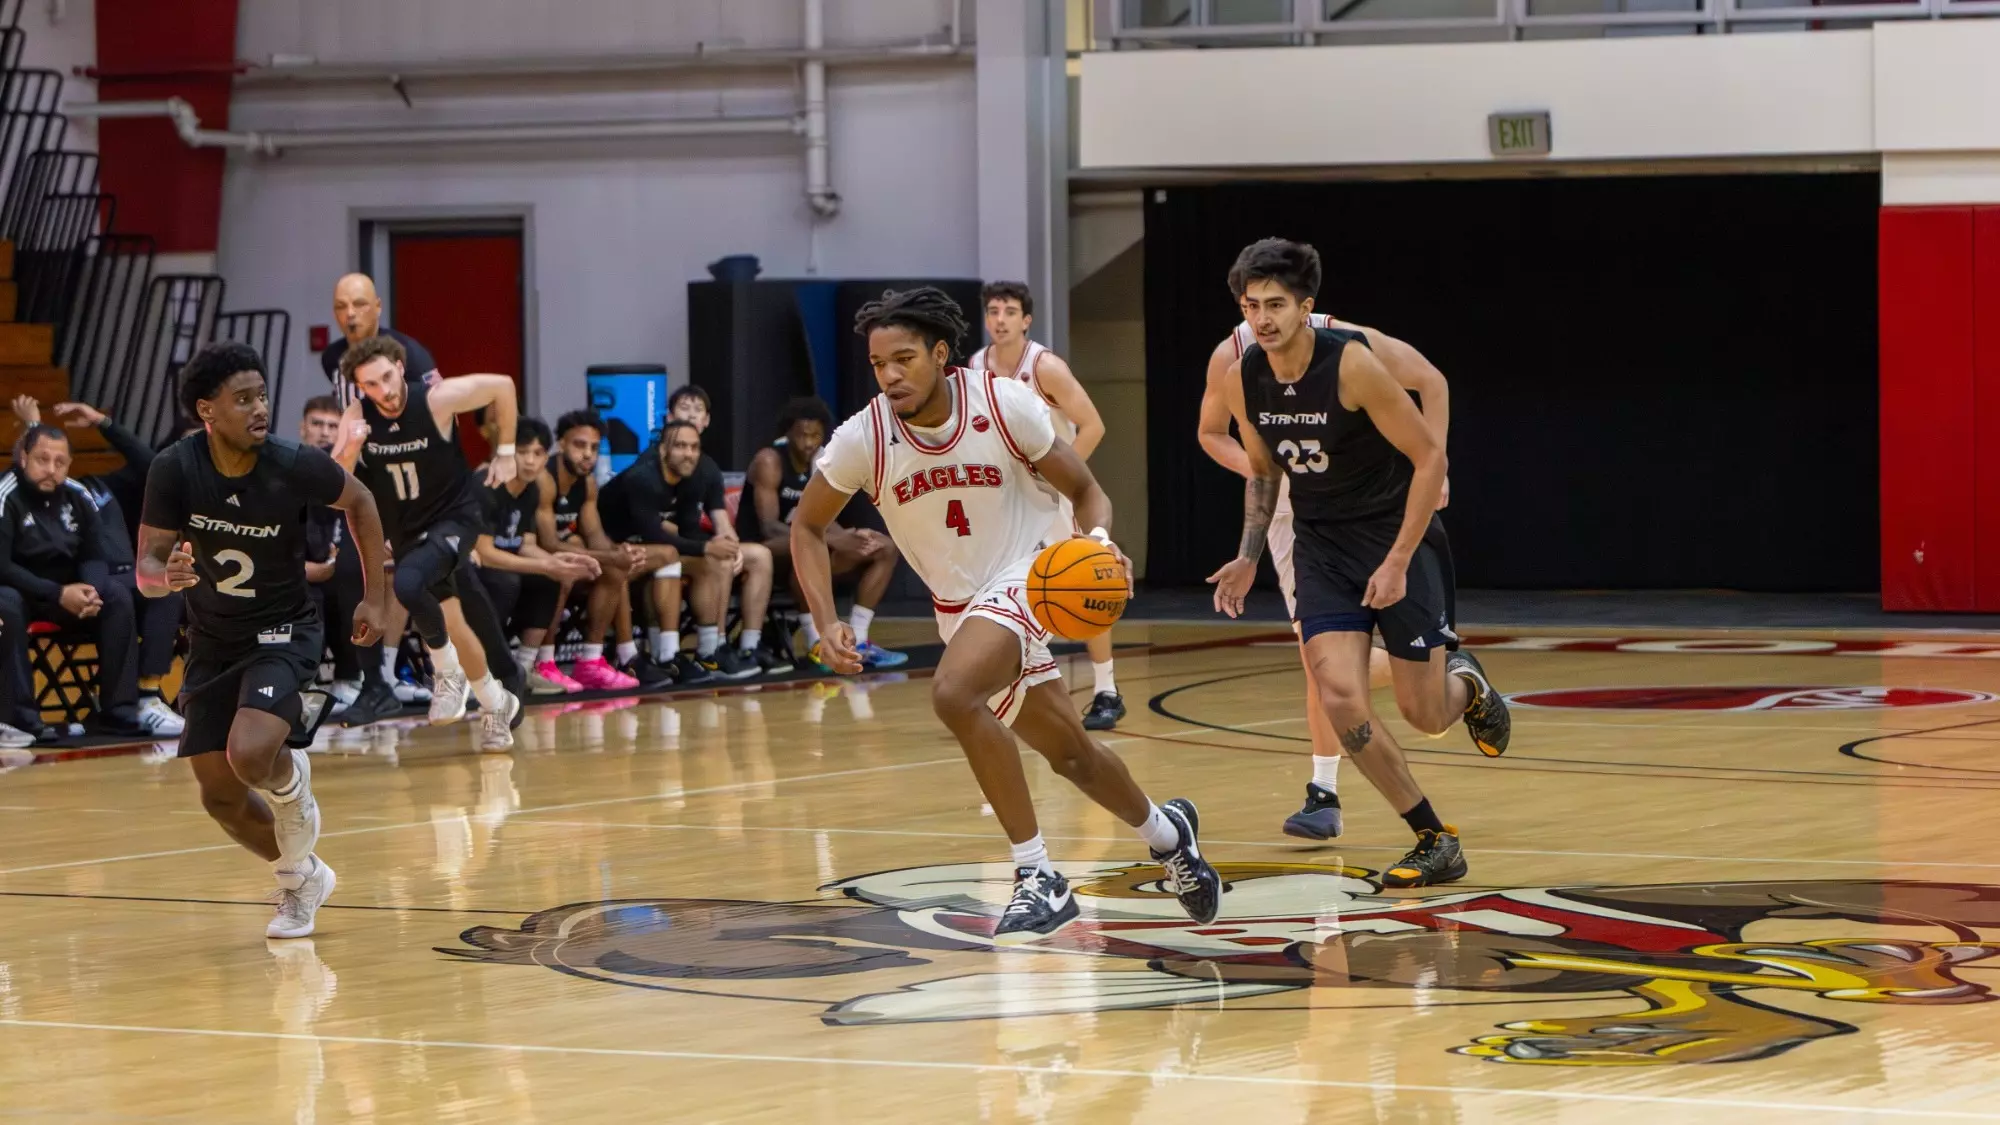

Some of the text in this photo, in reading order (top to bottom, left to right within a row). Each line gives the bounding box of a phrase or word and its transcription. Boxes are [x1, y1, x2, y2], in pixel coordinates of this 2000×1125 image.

[1499, 118, 1534, 149] EXIT
[1258, 412, 1327, 425] STANTON
[367, 437, 428, 455] STANTON
[1277, 439, 1329, 474] 23
[385, 462, 420, 501] 11
[892, 464, 1003, 506] EAGLES
[188, 513, 281, 538] STANTON
[945, 499, 972, 537] 4
[212, 548, 256, 598] 2
